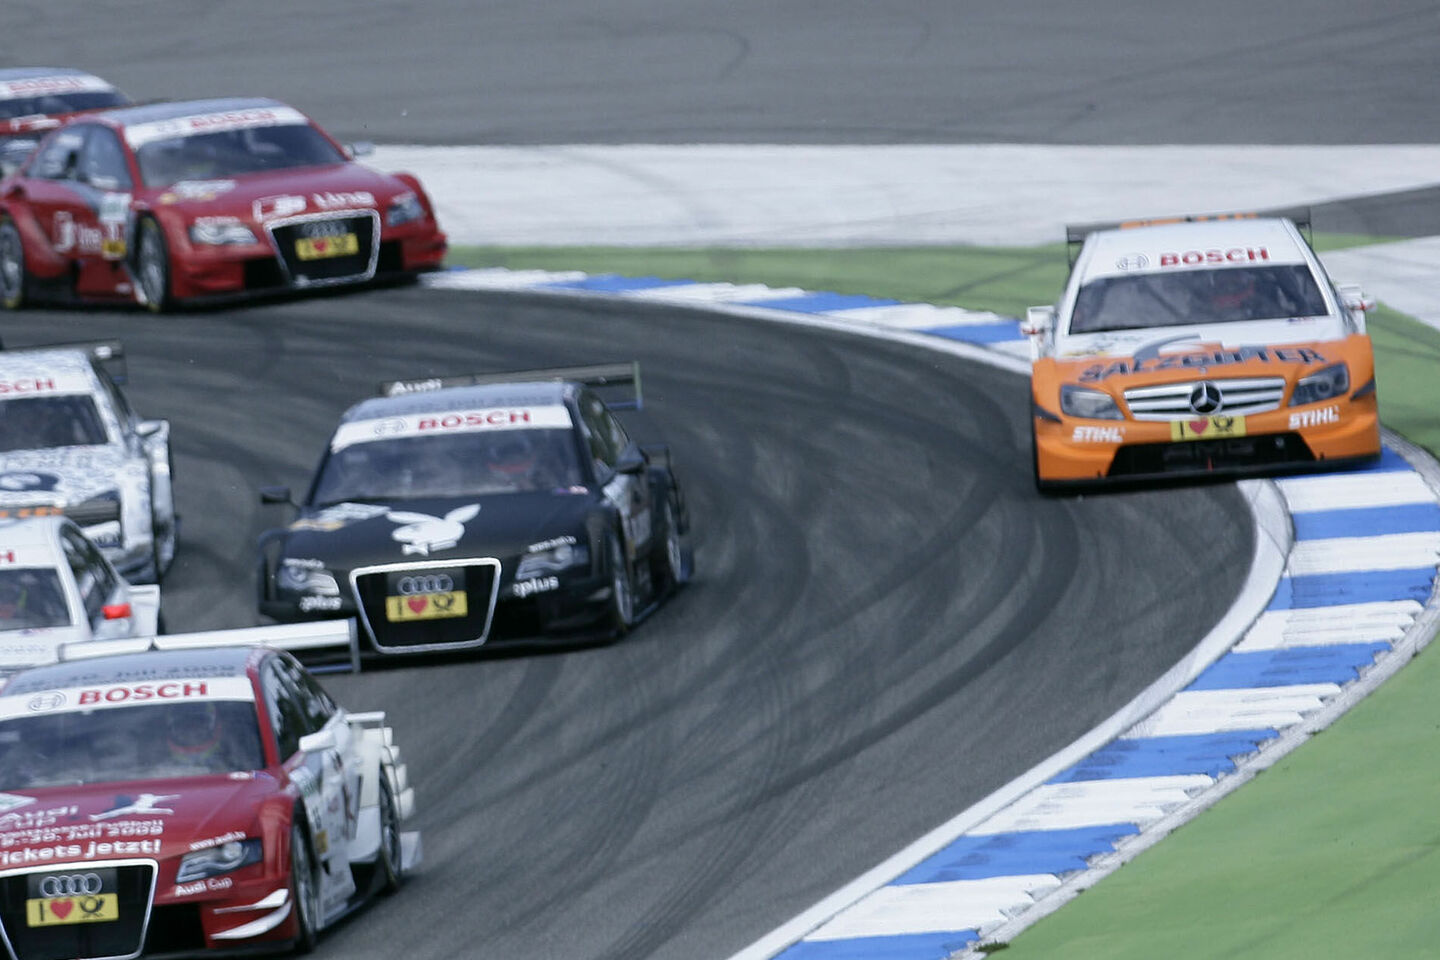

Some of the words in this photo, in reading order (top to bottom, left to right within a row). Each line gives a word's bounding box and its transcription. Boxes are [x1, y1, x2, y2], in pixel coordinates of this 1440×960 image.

[1160, 247, 1269, 267] BOSCH
[417, 410, 532, 431] BOSCH
[1288, 406, 1340, 430] STIHL
[1072, 426, 1122, 443] STIHL
[79, 682, 209, 705] BOSCH
[86, 838, 162, 859] jetzt!
[174, 880, 207, 897] Audi
